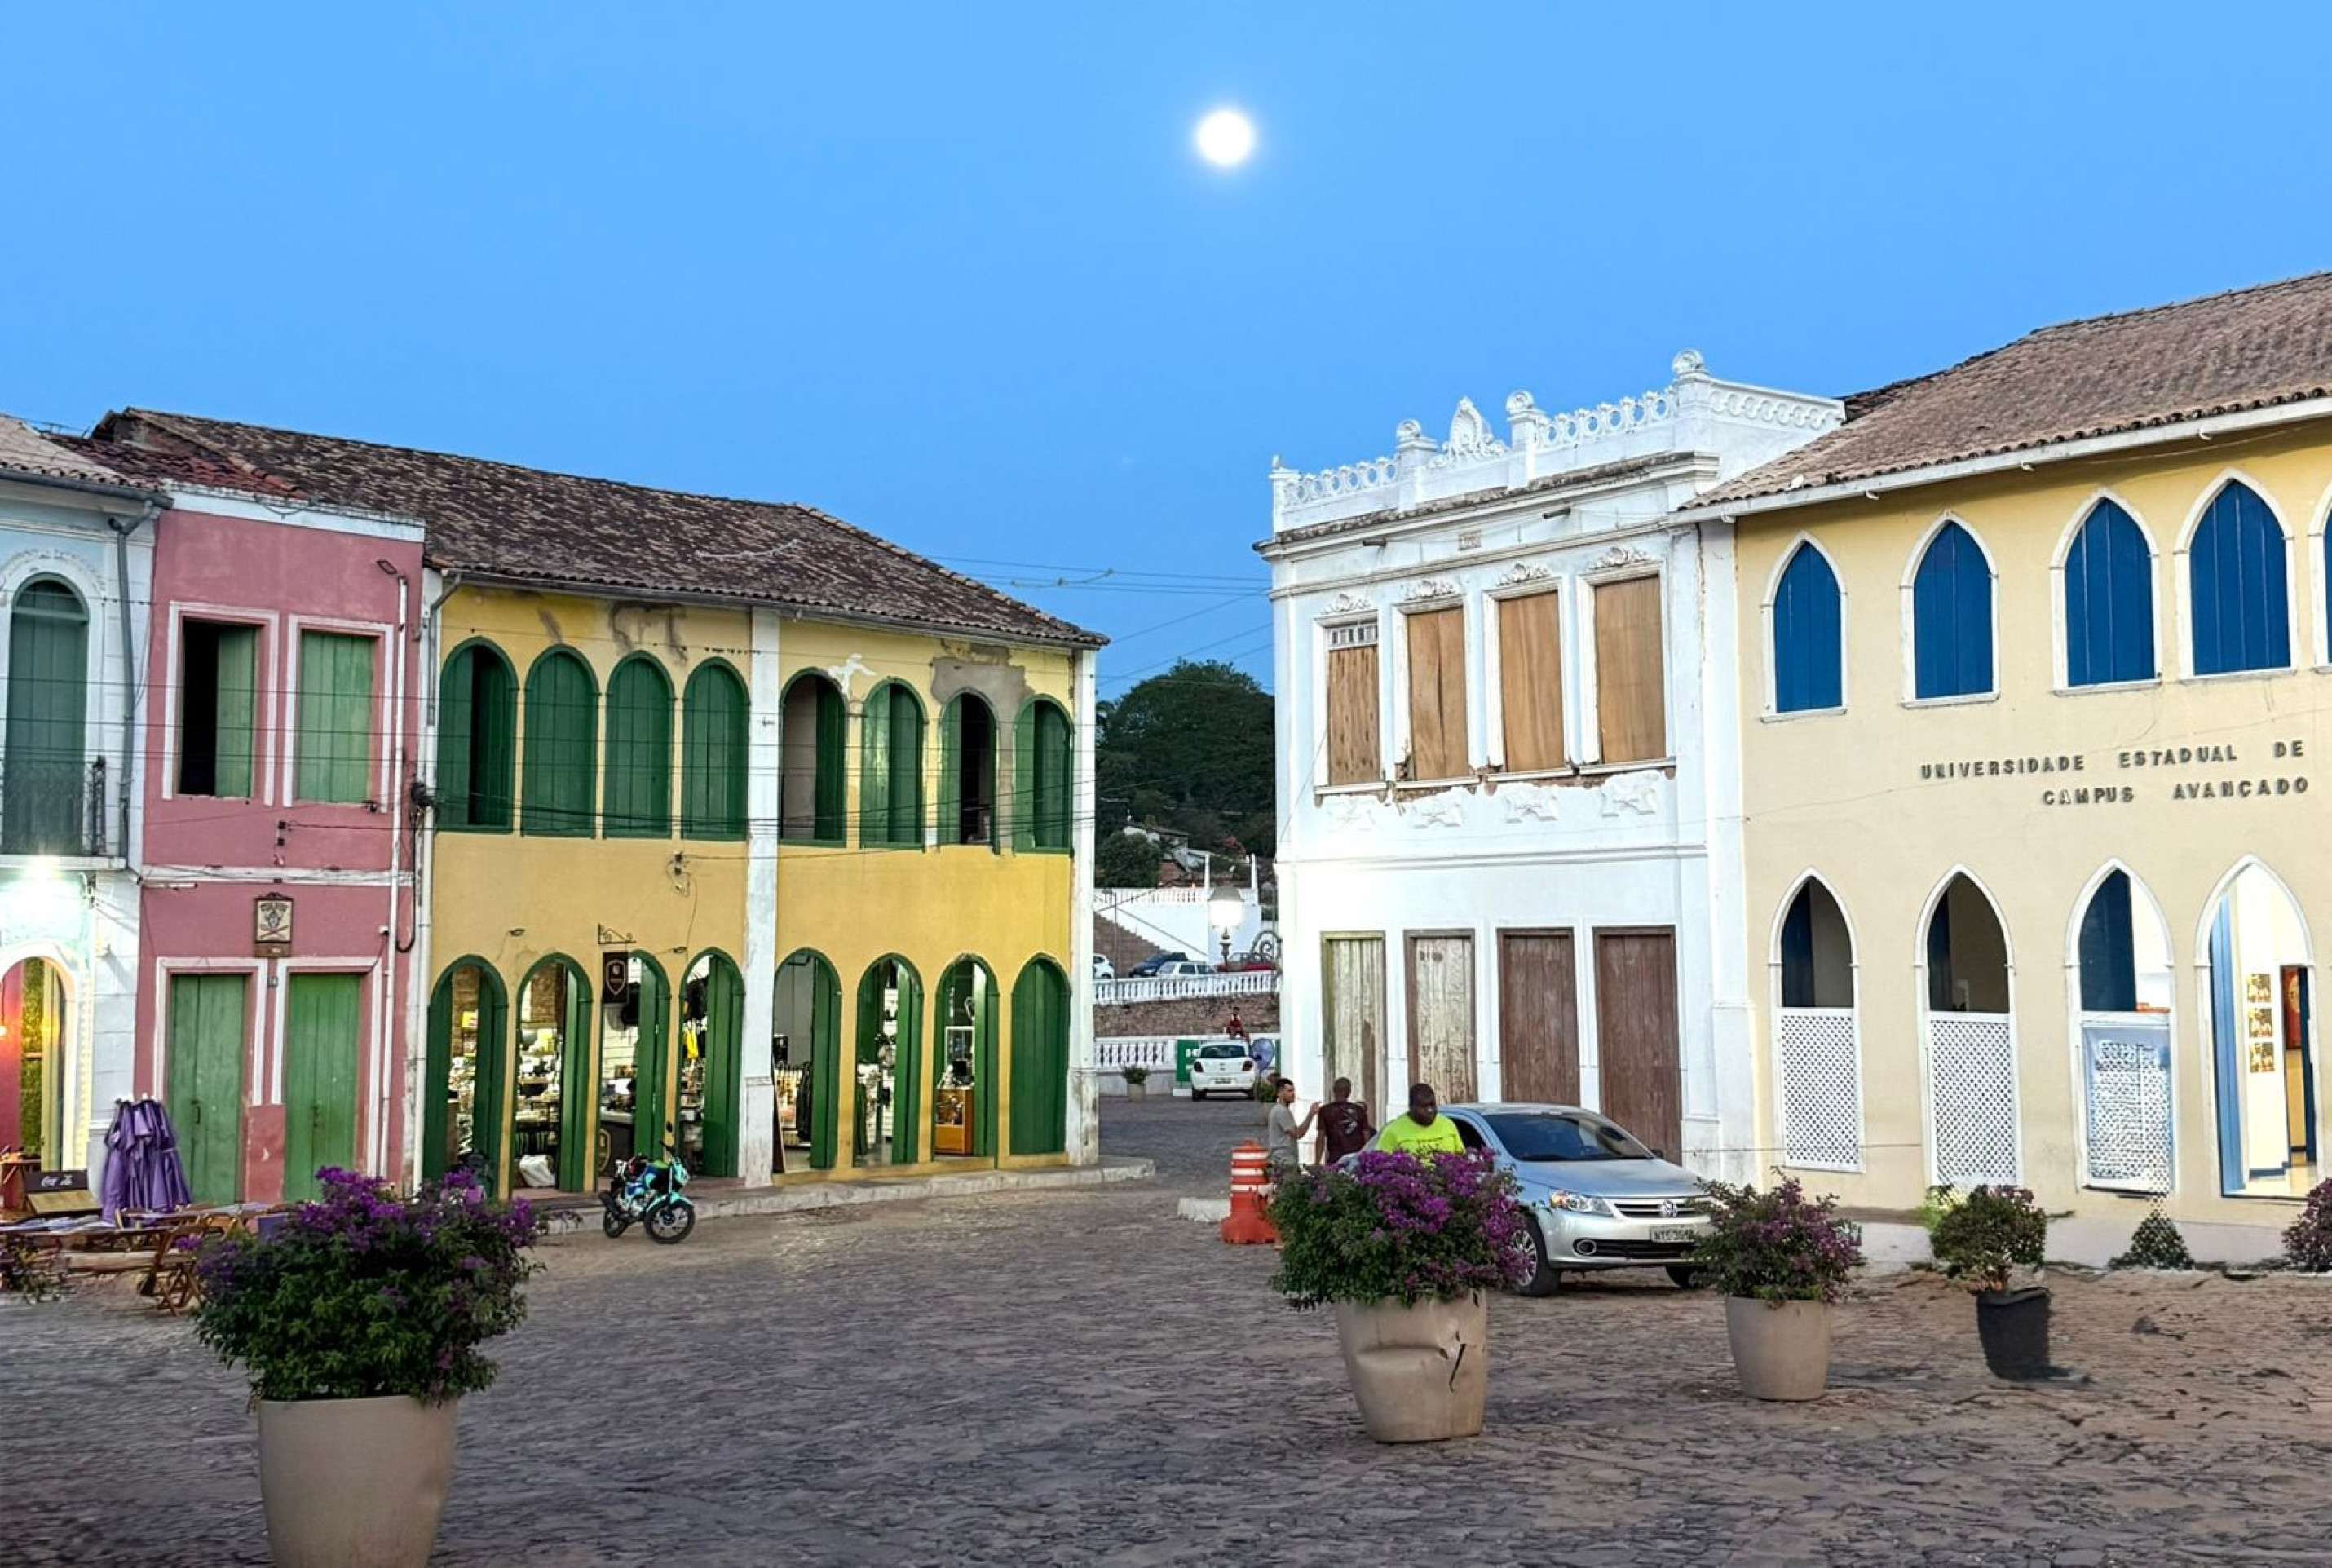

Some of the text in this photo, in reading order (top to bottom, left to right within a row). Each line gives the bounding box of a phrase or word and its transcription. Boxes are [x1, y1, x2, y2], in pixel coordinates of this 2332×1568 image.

[1921, 740, 2303, 779] UNIVERSIDADE ESTADUAL DE
[2043, 786, 2135, 805] CAMPUS
